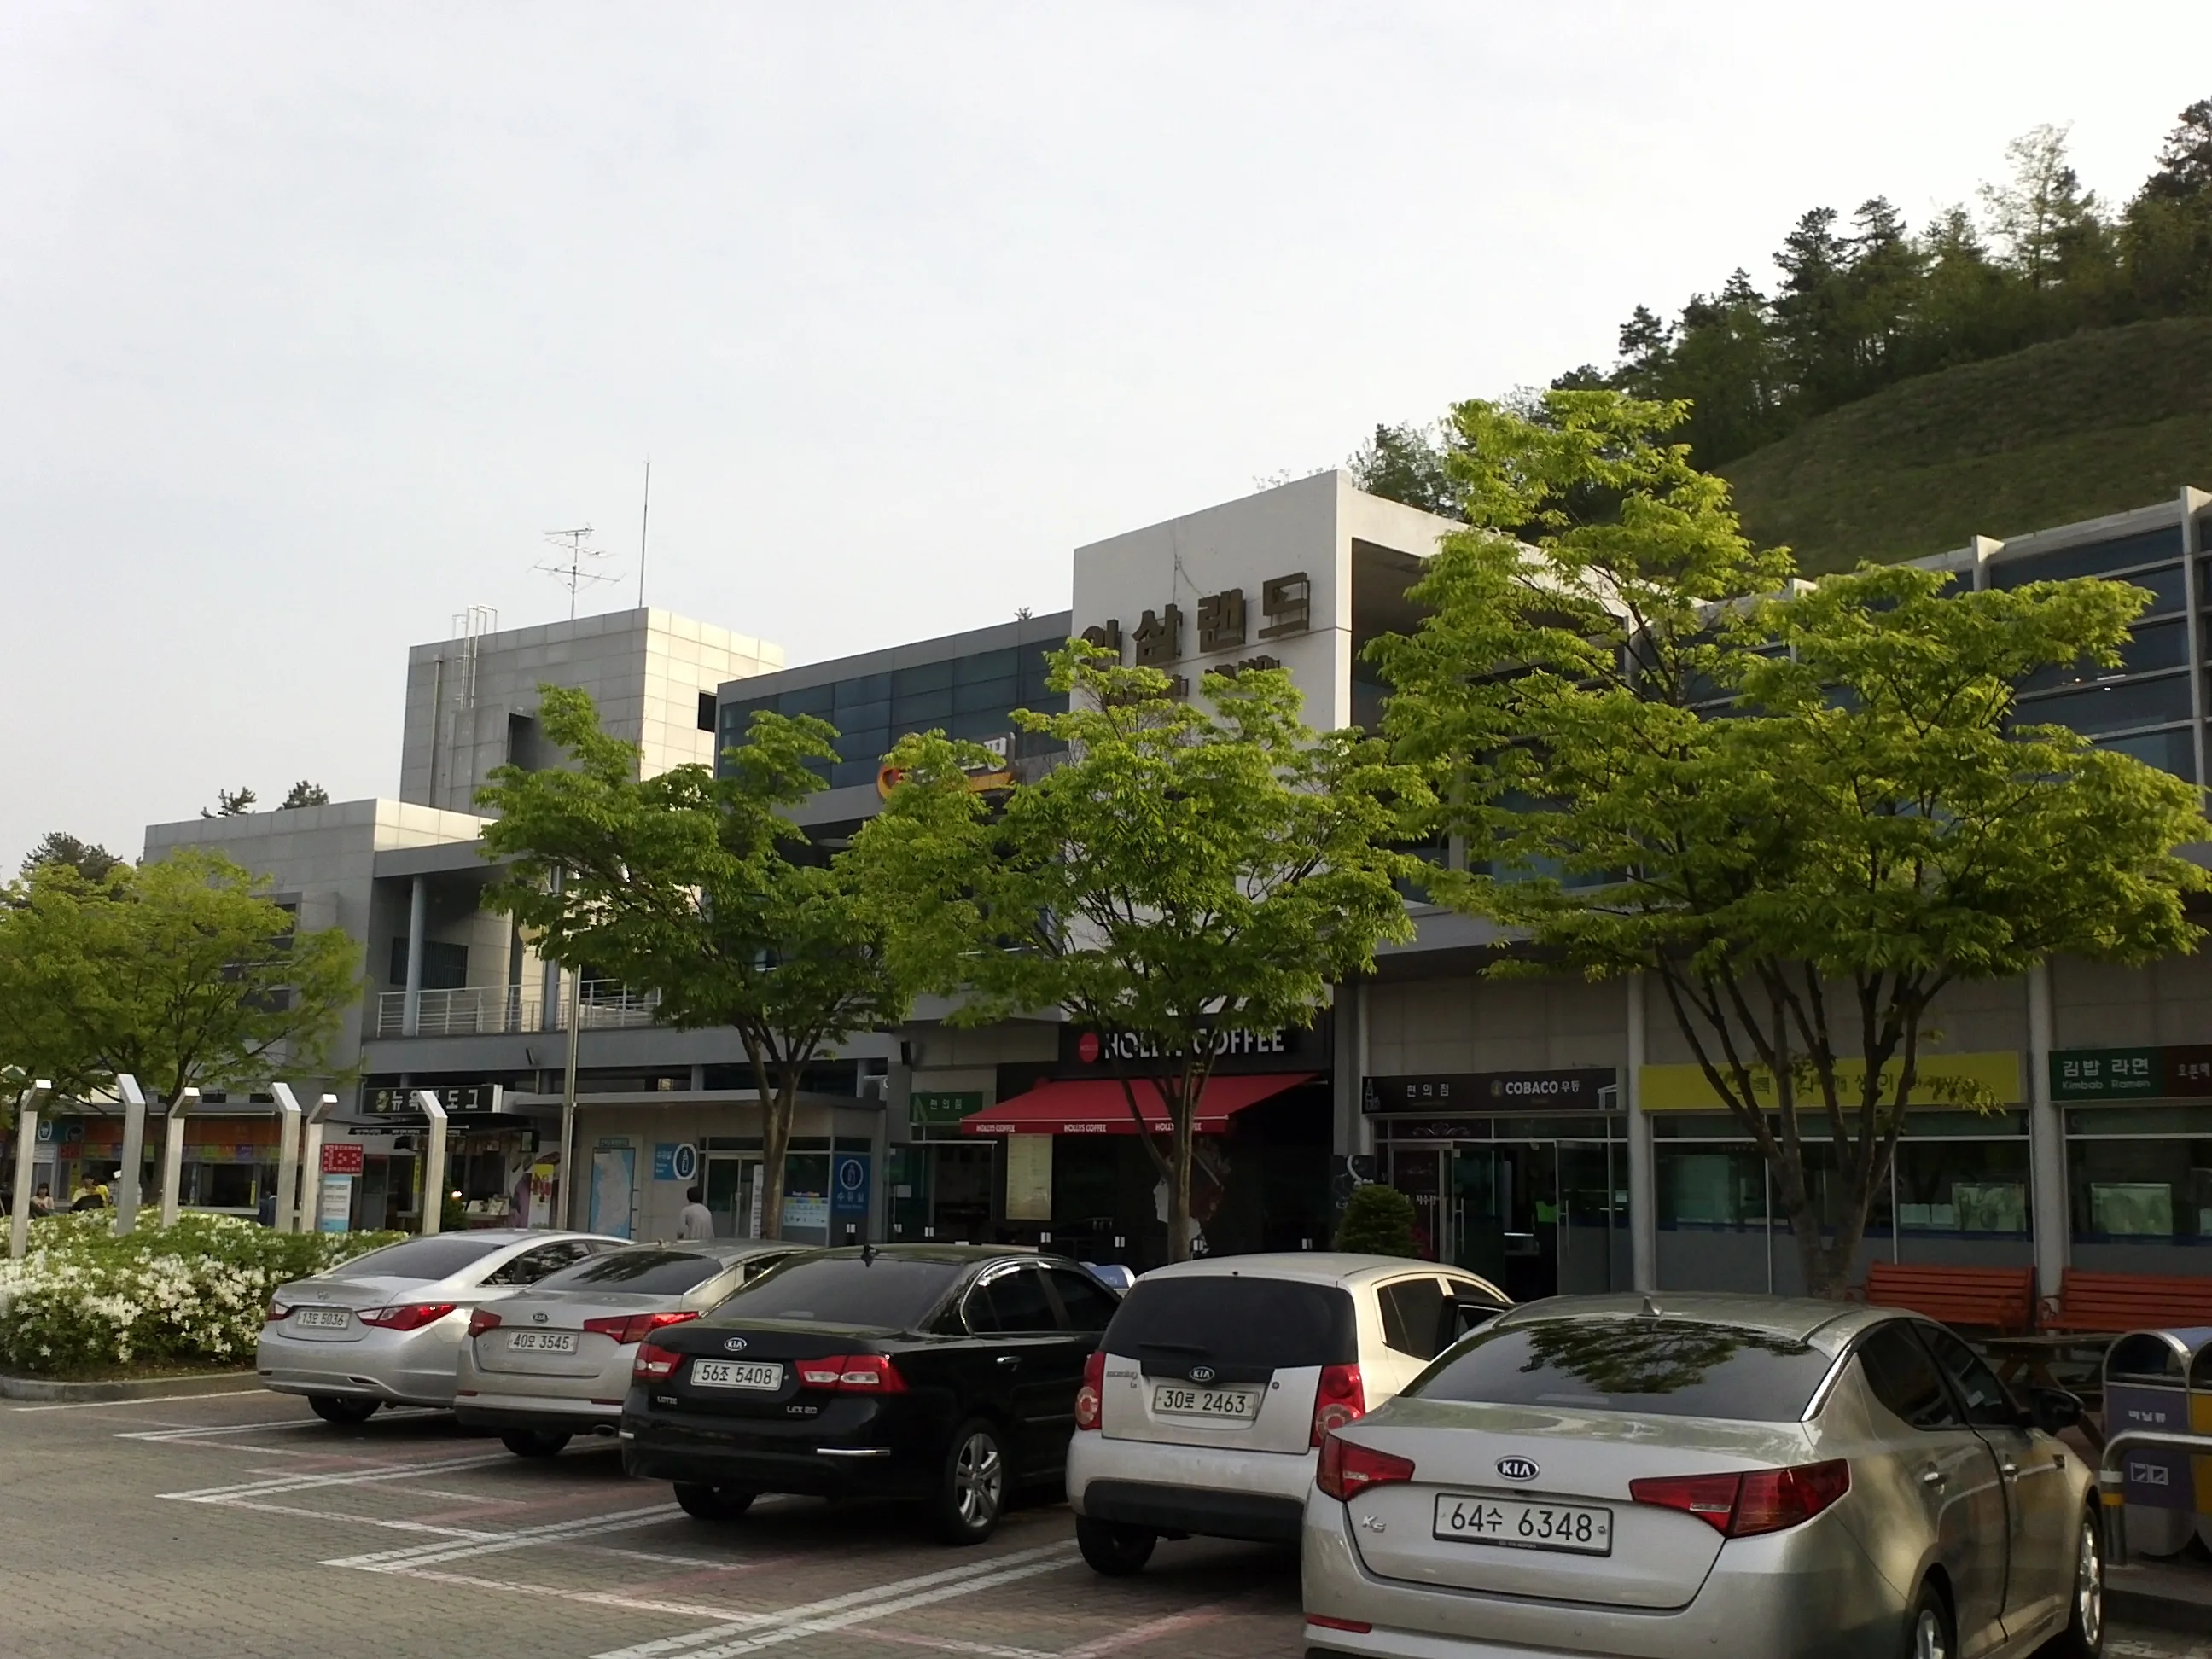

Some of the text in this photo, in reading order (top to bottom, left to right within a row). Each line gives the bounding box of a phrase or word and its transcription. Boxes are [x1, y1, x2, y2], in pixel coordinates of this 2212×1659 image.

[2062, 1058, 2149, 1077] 김밥 라면
[1406, 1083, 1449, 1097] 편의점
[1505, 1081, 1558, 1095] COBACO
[2062, 1080, 2151, 1090] Kimbab Ramen
[392, 1089, 478, 1111] 뉴욕도그
[930, 1098, 962, 1110] 편의점
[1155, 1122, 1175, 1132] HOLLY
[321, 1313, 344, 1326] 5036
[539, 1335, 569, 1350] 3545
[727, 1340, 742, 1348] KIA
[701, 1365, 772, 1385] 56조 5408
[1193, 1370, 1210, 1378] KIA
[1164, 1390, 1246, 1413] 30로 2463
[1502, 1461, 1531, 1476] KIA
[1451, 1502, 1592, 1543] 64수 6348
